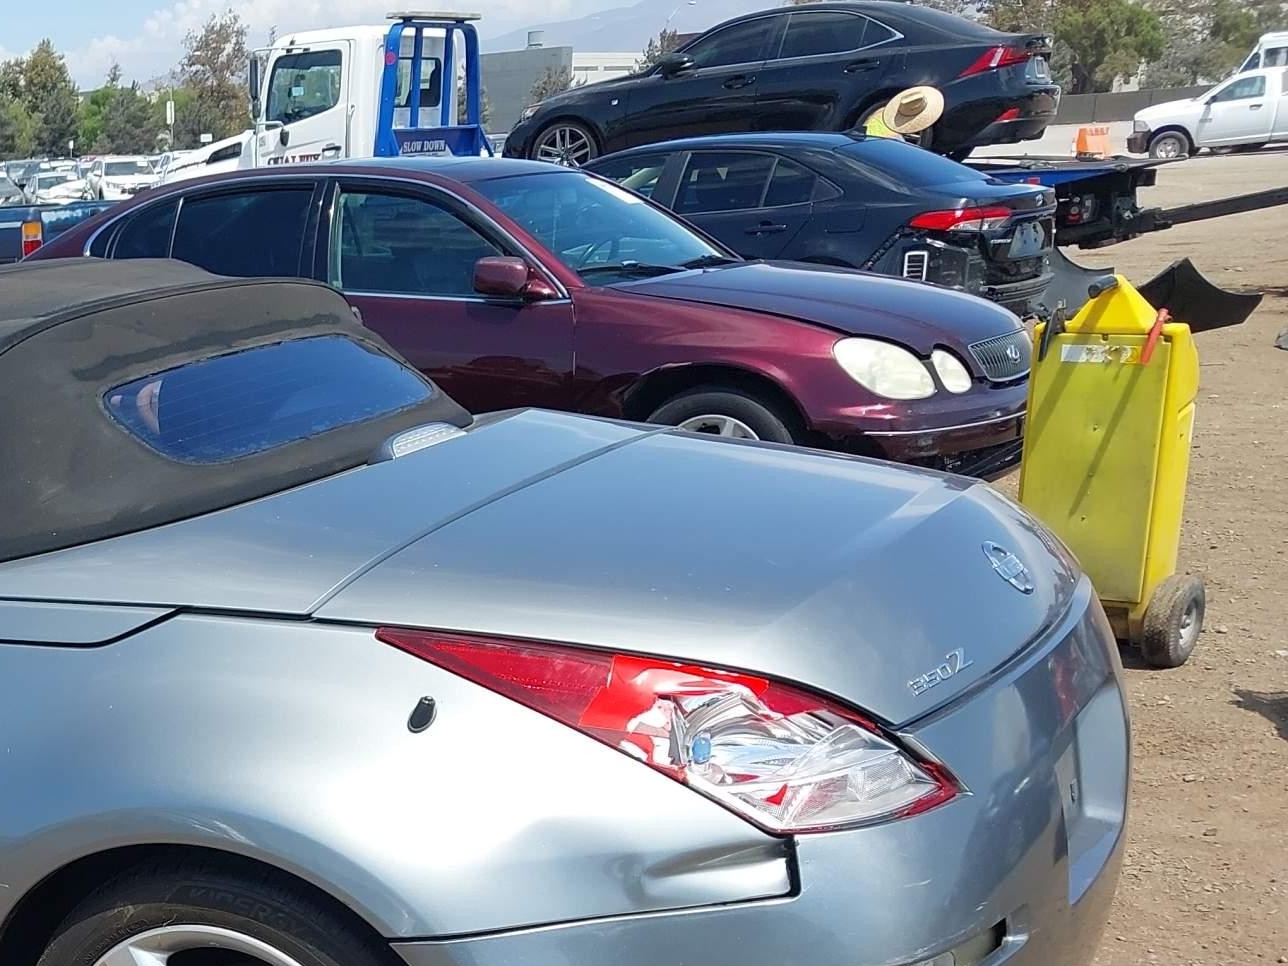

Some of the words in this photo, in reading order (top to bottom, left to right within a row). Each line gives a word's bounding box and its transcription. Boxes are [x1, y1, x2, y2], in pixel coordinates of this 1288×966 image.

[403, 140, 423, 153] SLOW
[423, 139, 446, 152] DOWN
[908, 648, 974, 696] 350Z
